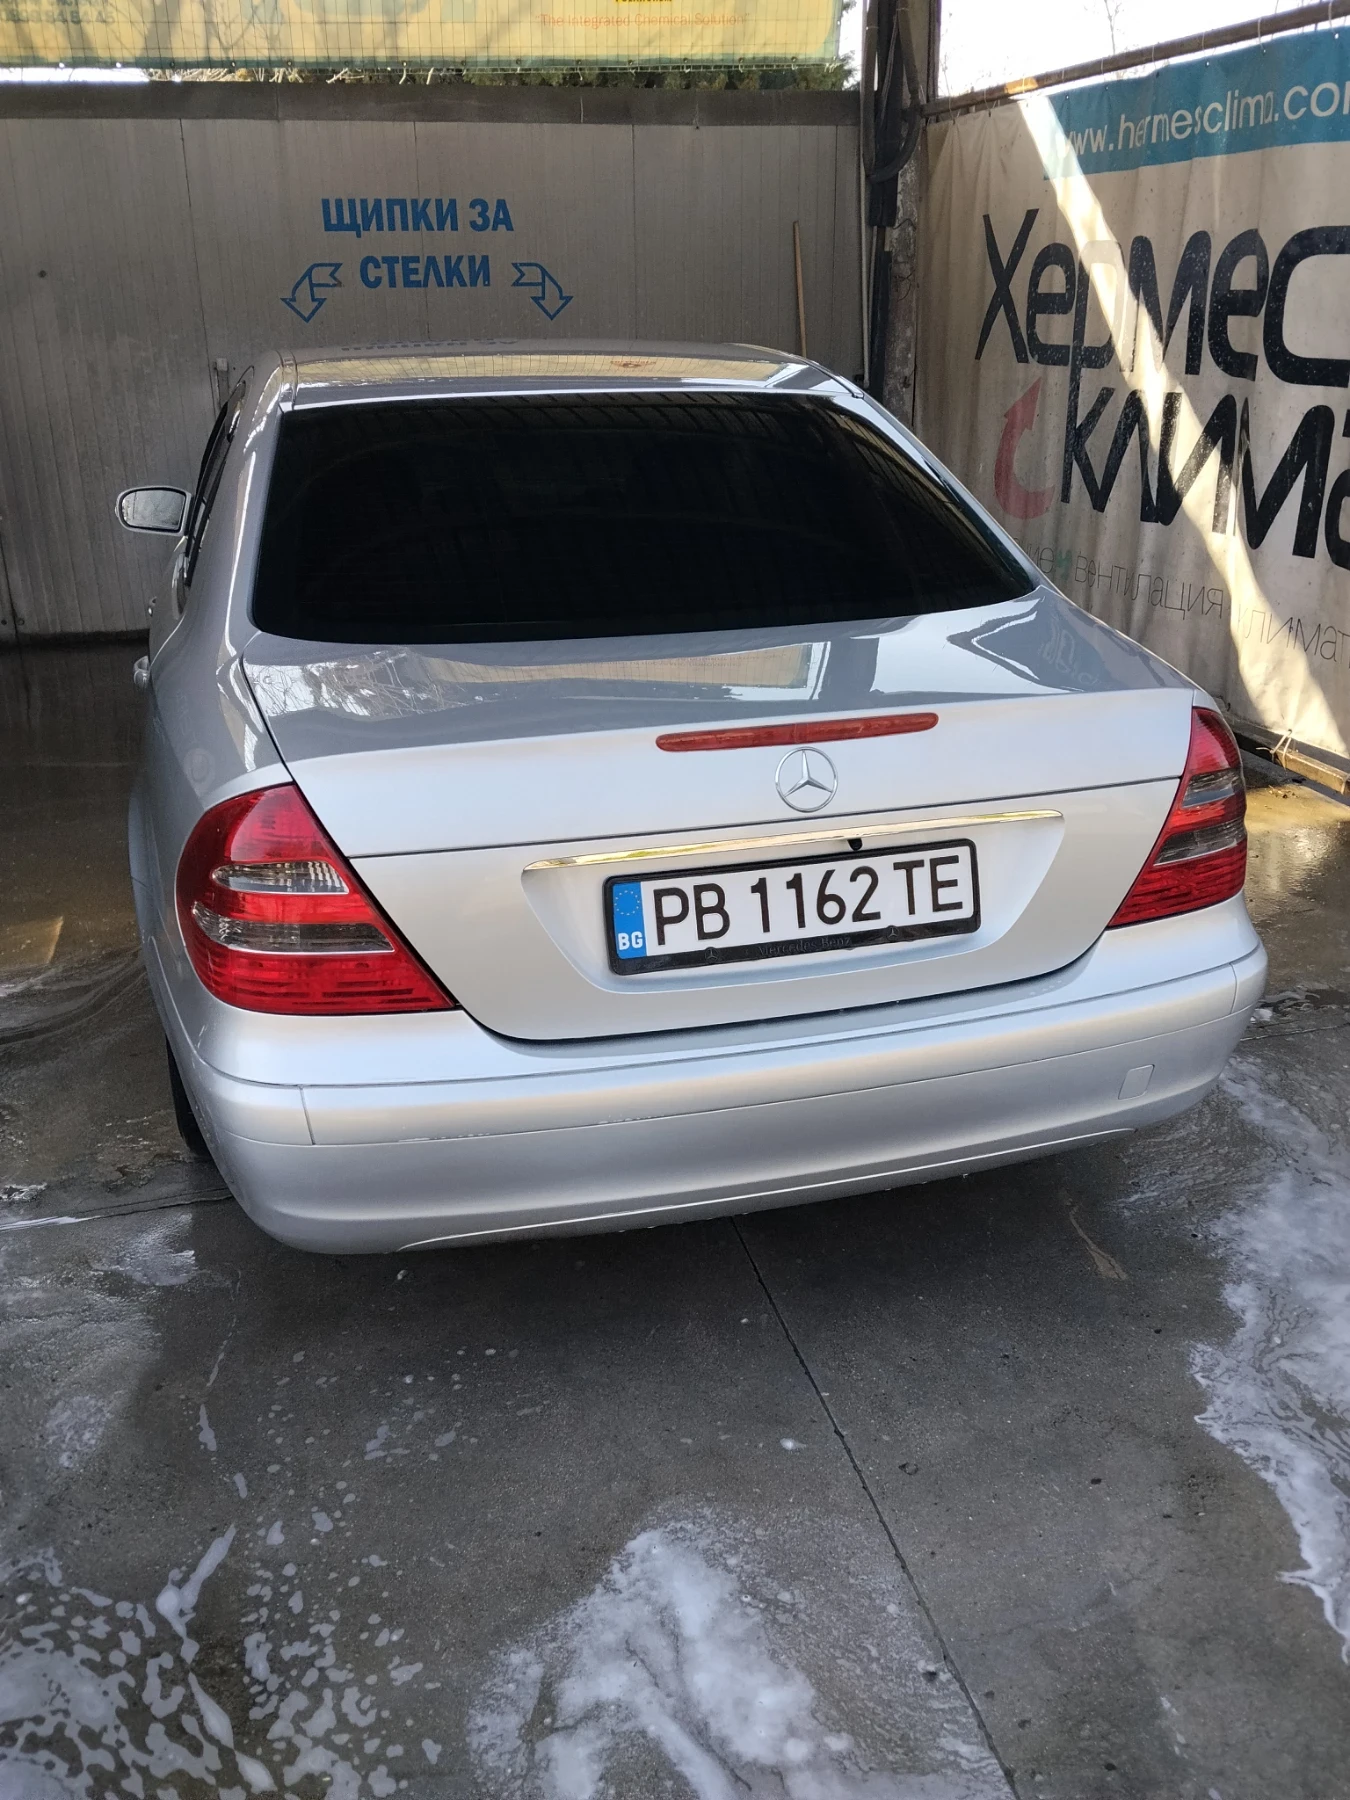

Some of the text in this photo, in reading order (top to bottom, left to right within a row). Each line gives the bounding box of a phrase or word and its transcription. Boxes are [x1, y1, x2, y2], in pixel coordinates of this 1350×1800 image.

[568, 14, 630, 29] Integrated
[634, 13, 691, 27] Chemical
[321, 198, 514, 238] ЩИПКИ ЗА
[360, 254, 490, 289] СТЕЛКИ
[1074, 550, 1224, 621] вентилация
[750, 865, 882, 934] 1162
[892, 854, 964, 917] TE
[617, 930, 644, 951] BG
